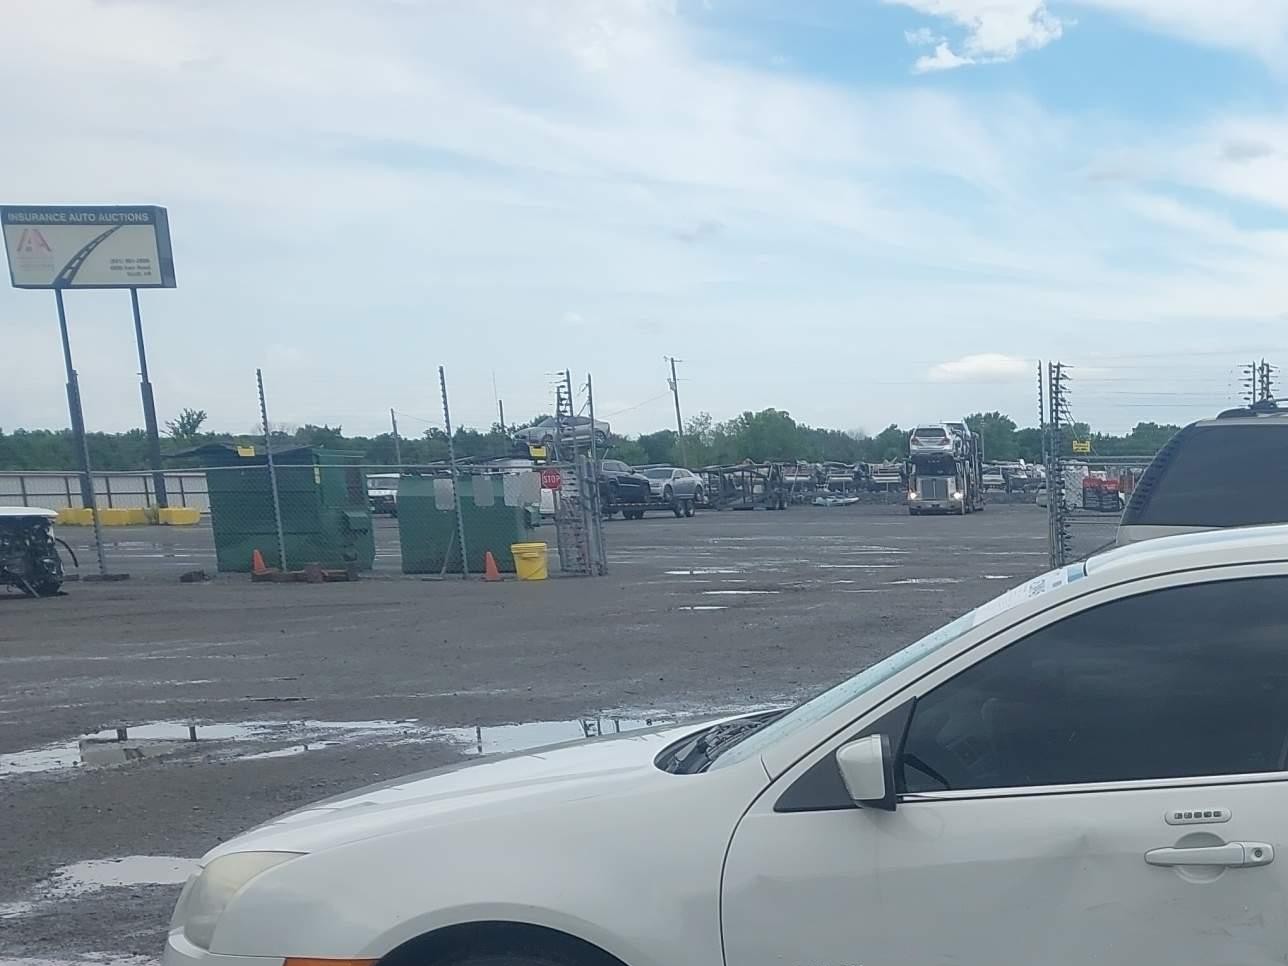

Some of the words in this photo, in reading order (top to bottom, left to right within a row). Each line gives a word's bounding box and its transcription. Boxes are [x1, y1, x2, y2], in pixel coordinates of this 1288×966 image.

[8, 212, 67, 222] INSURANCE
[69, 212, 96, 222] AUTO
[98, 212, 149, 222] AUCTIONS
[543, 474, 560, 484] STOP
